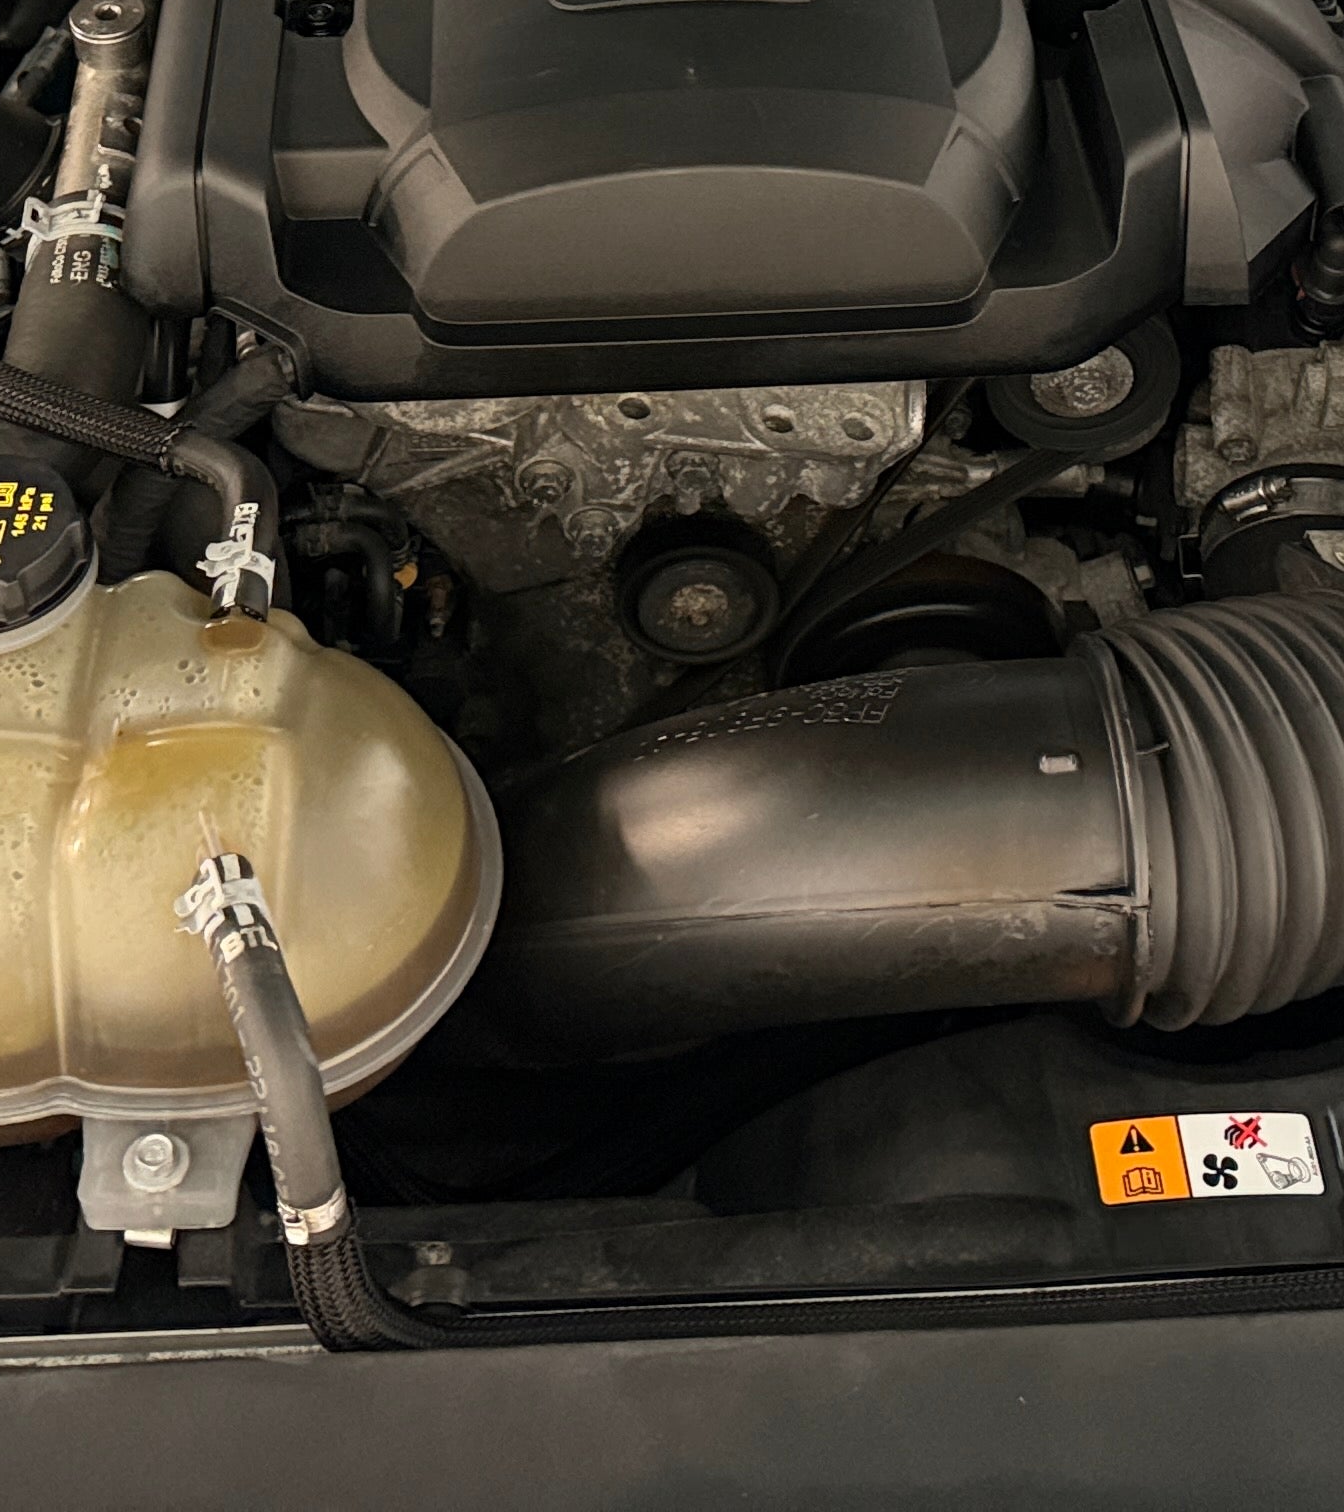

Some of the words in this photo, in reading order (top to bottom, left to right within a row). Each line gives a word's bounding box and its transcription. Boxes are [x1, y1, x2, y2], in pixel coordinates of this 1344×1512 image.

[69, 250, 92, 281] ENG
[17, 486, 38, 512] kPa
[39, 492, 55, 513] psi
[10, 512, 30, 538] 145
[31, 515, 49, 532] 21
